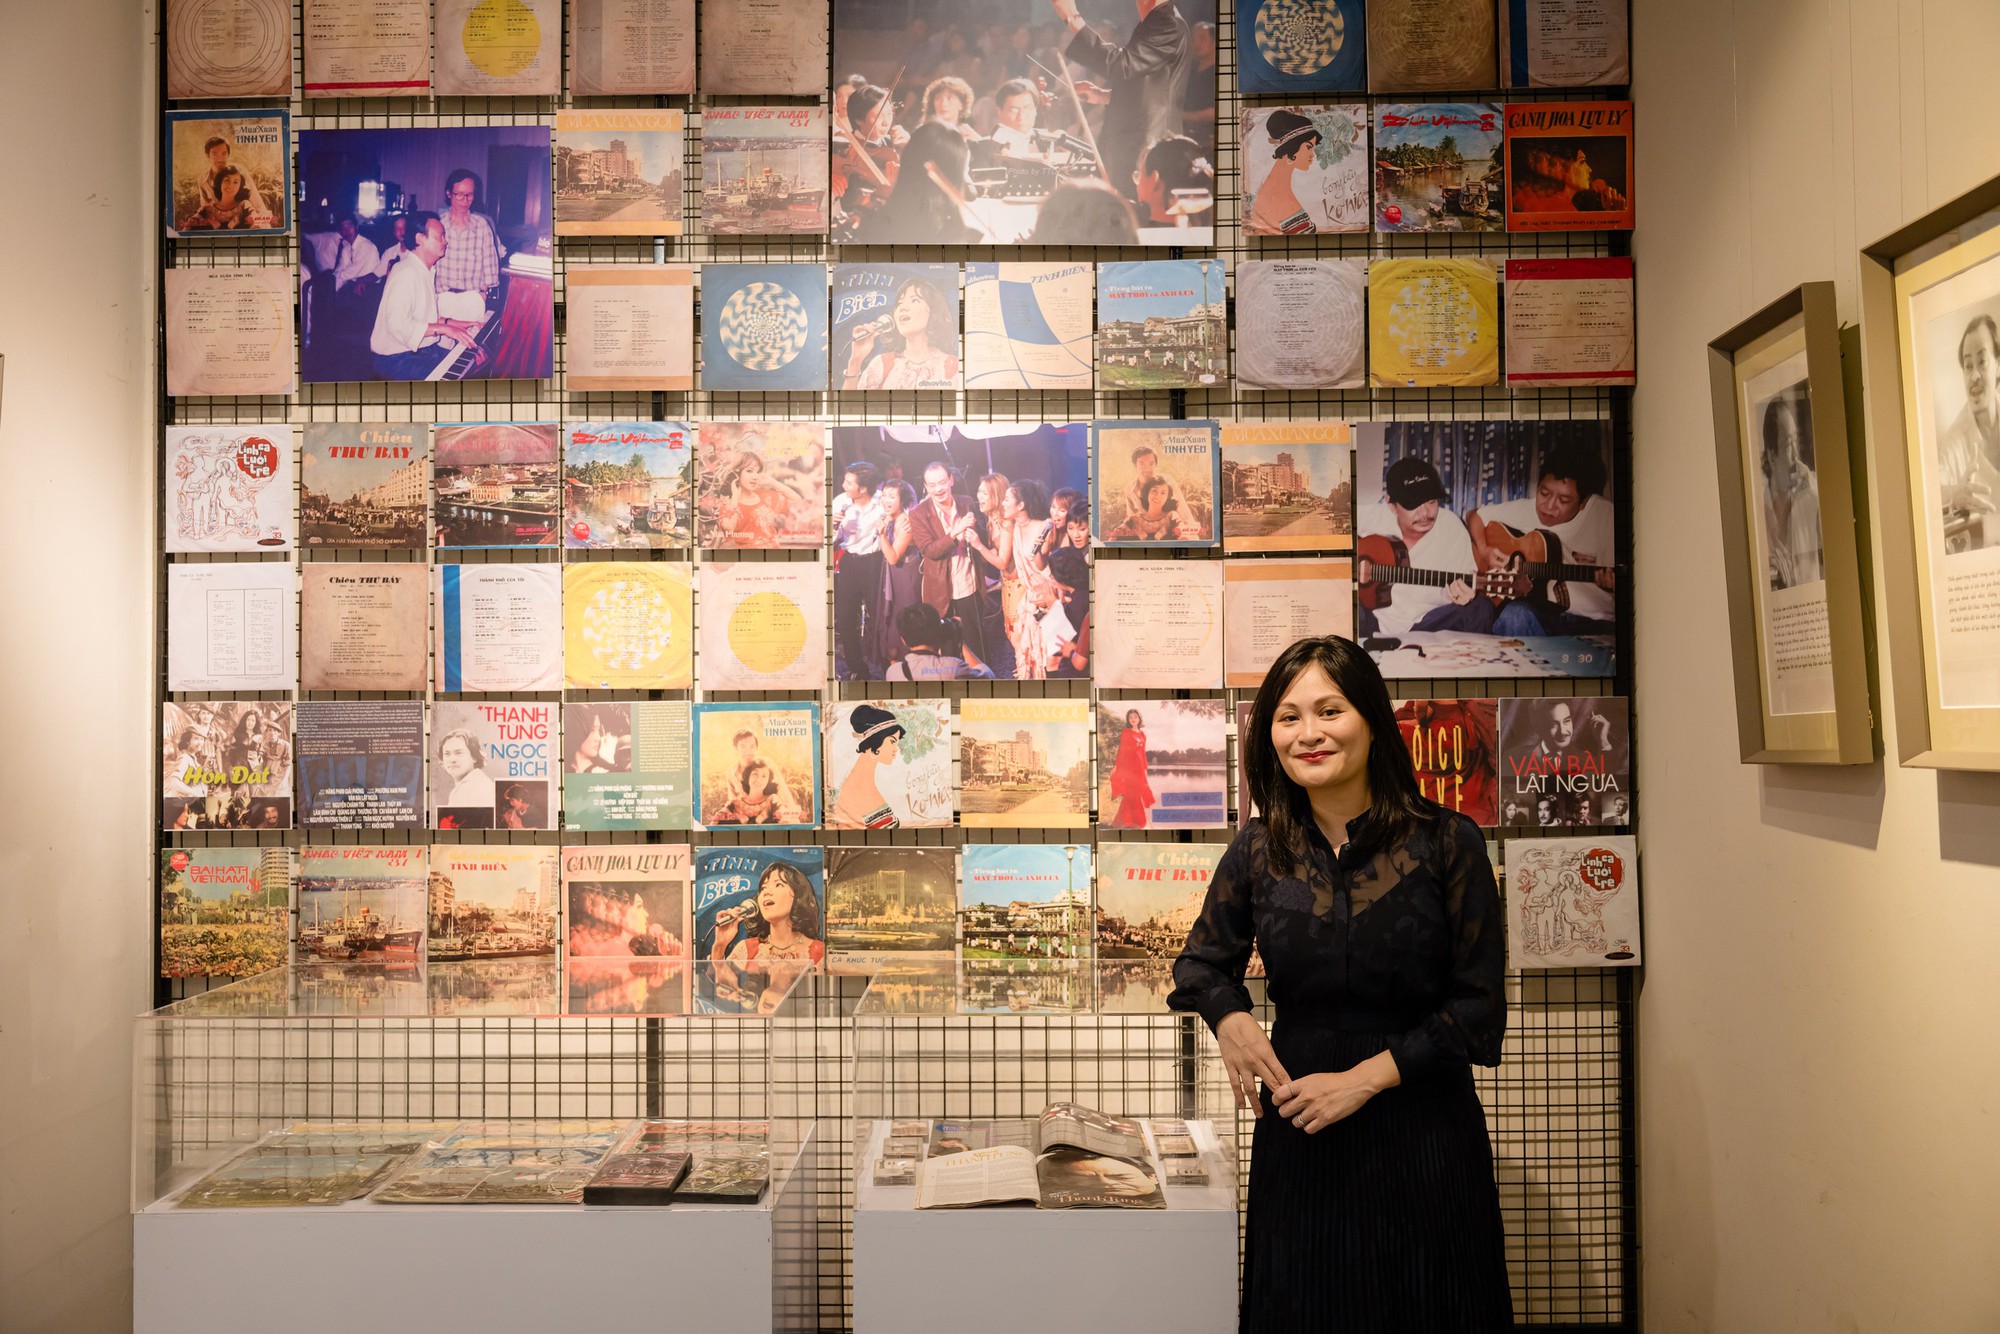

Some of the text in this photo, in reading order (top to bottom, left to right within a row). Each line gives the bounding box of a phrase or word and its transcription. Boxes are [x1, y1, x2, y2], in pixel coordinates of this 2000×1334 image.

[485, 706, 549, 722] THANH
[1508, 750, 1605, 776] VÁN BÀI
[1516, 773, 1549, 793] LẬT
